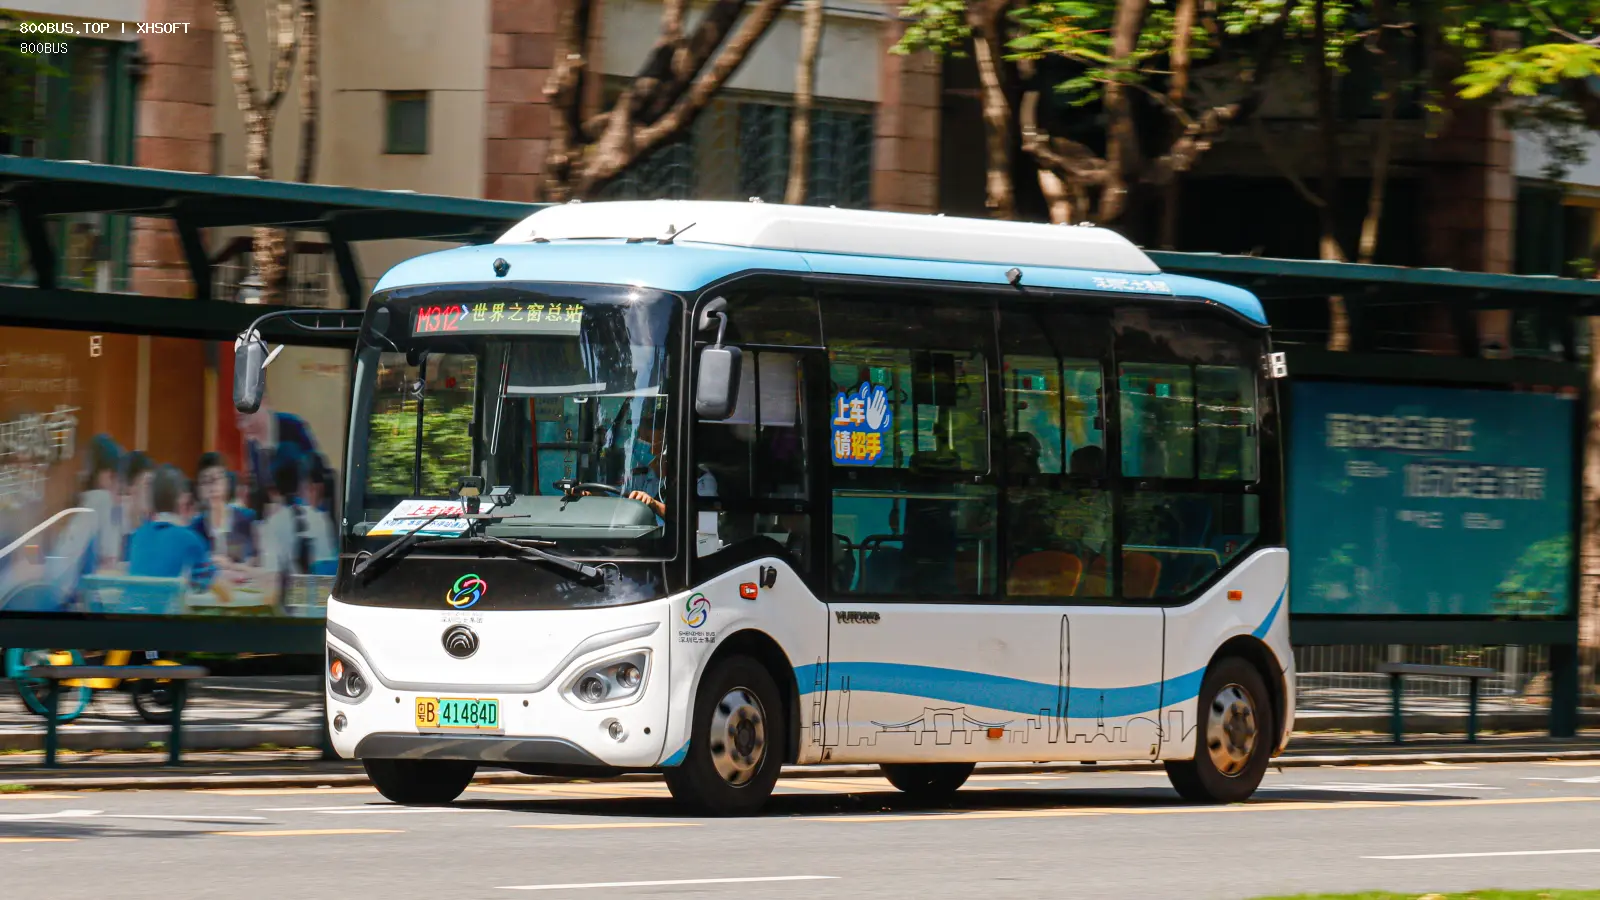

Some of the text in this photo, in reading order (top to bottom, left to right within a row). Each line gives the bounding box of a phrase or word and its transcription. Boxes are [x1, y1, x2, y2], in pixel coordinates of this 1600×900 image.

[416, 302, 583, 333] M312 世界之窗总站
[833, 396, 866, 427] 上车
[833, 430, 882, 460] 请招手
[443, 702, 497, 724] 41484D
